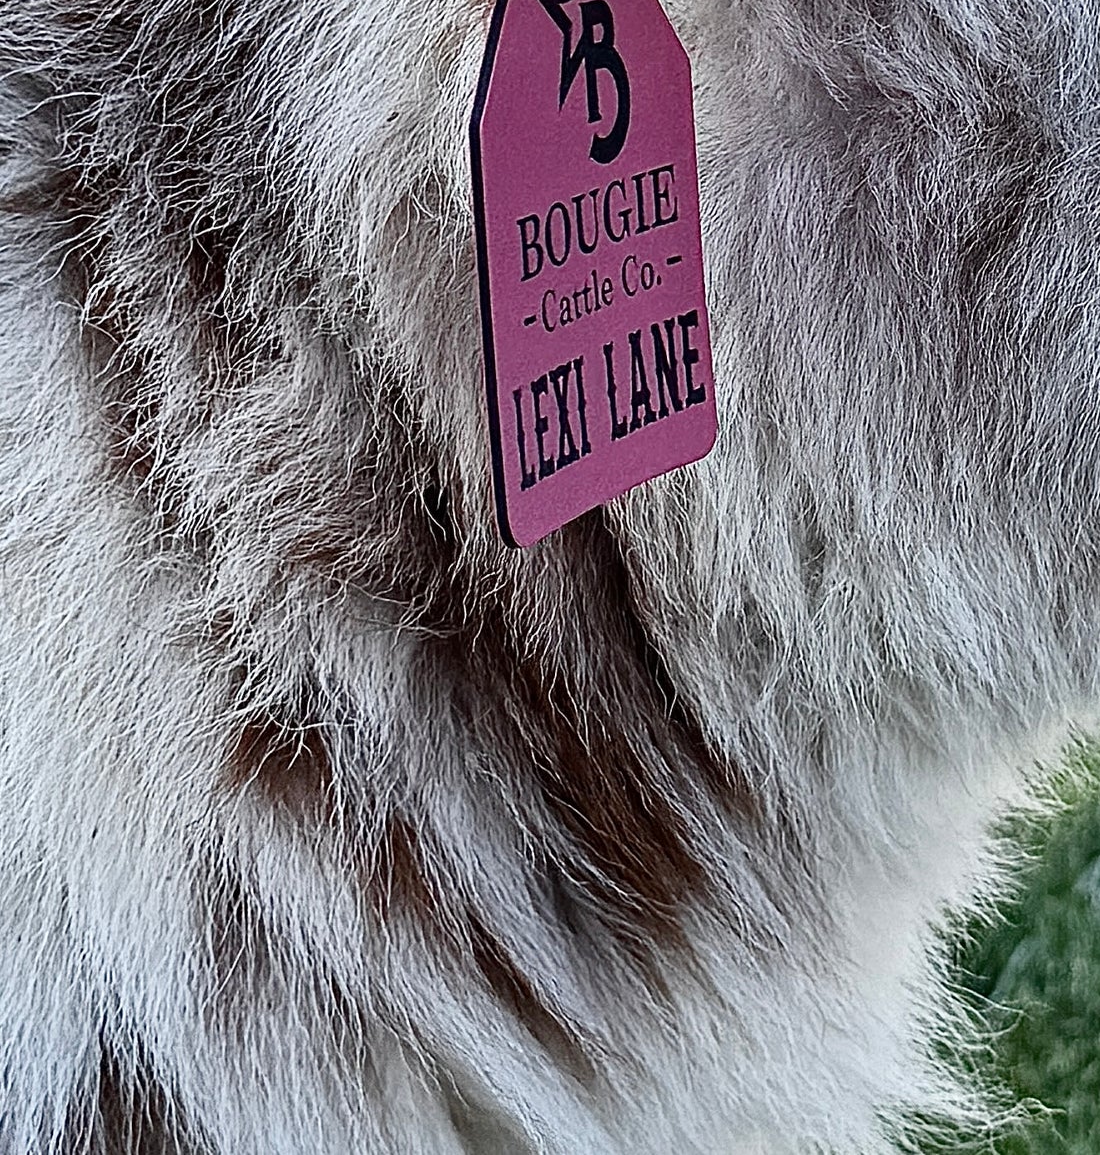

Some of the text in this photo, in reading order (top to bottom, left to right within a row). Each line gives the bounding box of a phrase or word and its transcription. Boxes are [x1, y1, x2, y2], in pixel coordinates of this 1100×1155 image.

[517, 165, 679, 282] BOUGIE
[513, 309, 706, 491] LEXI LANE
